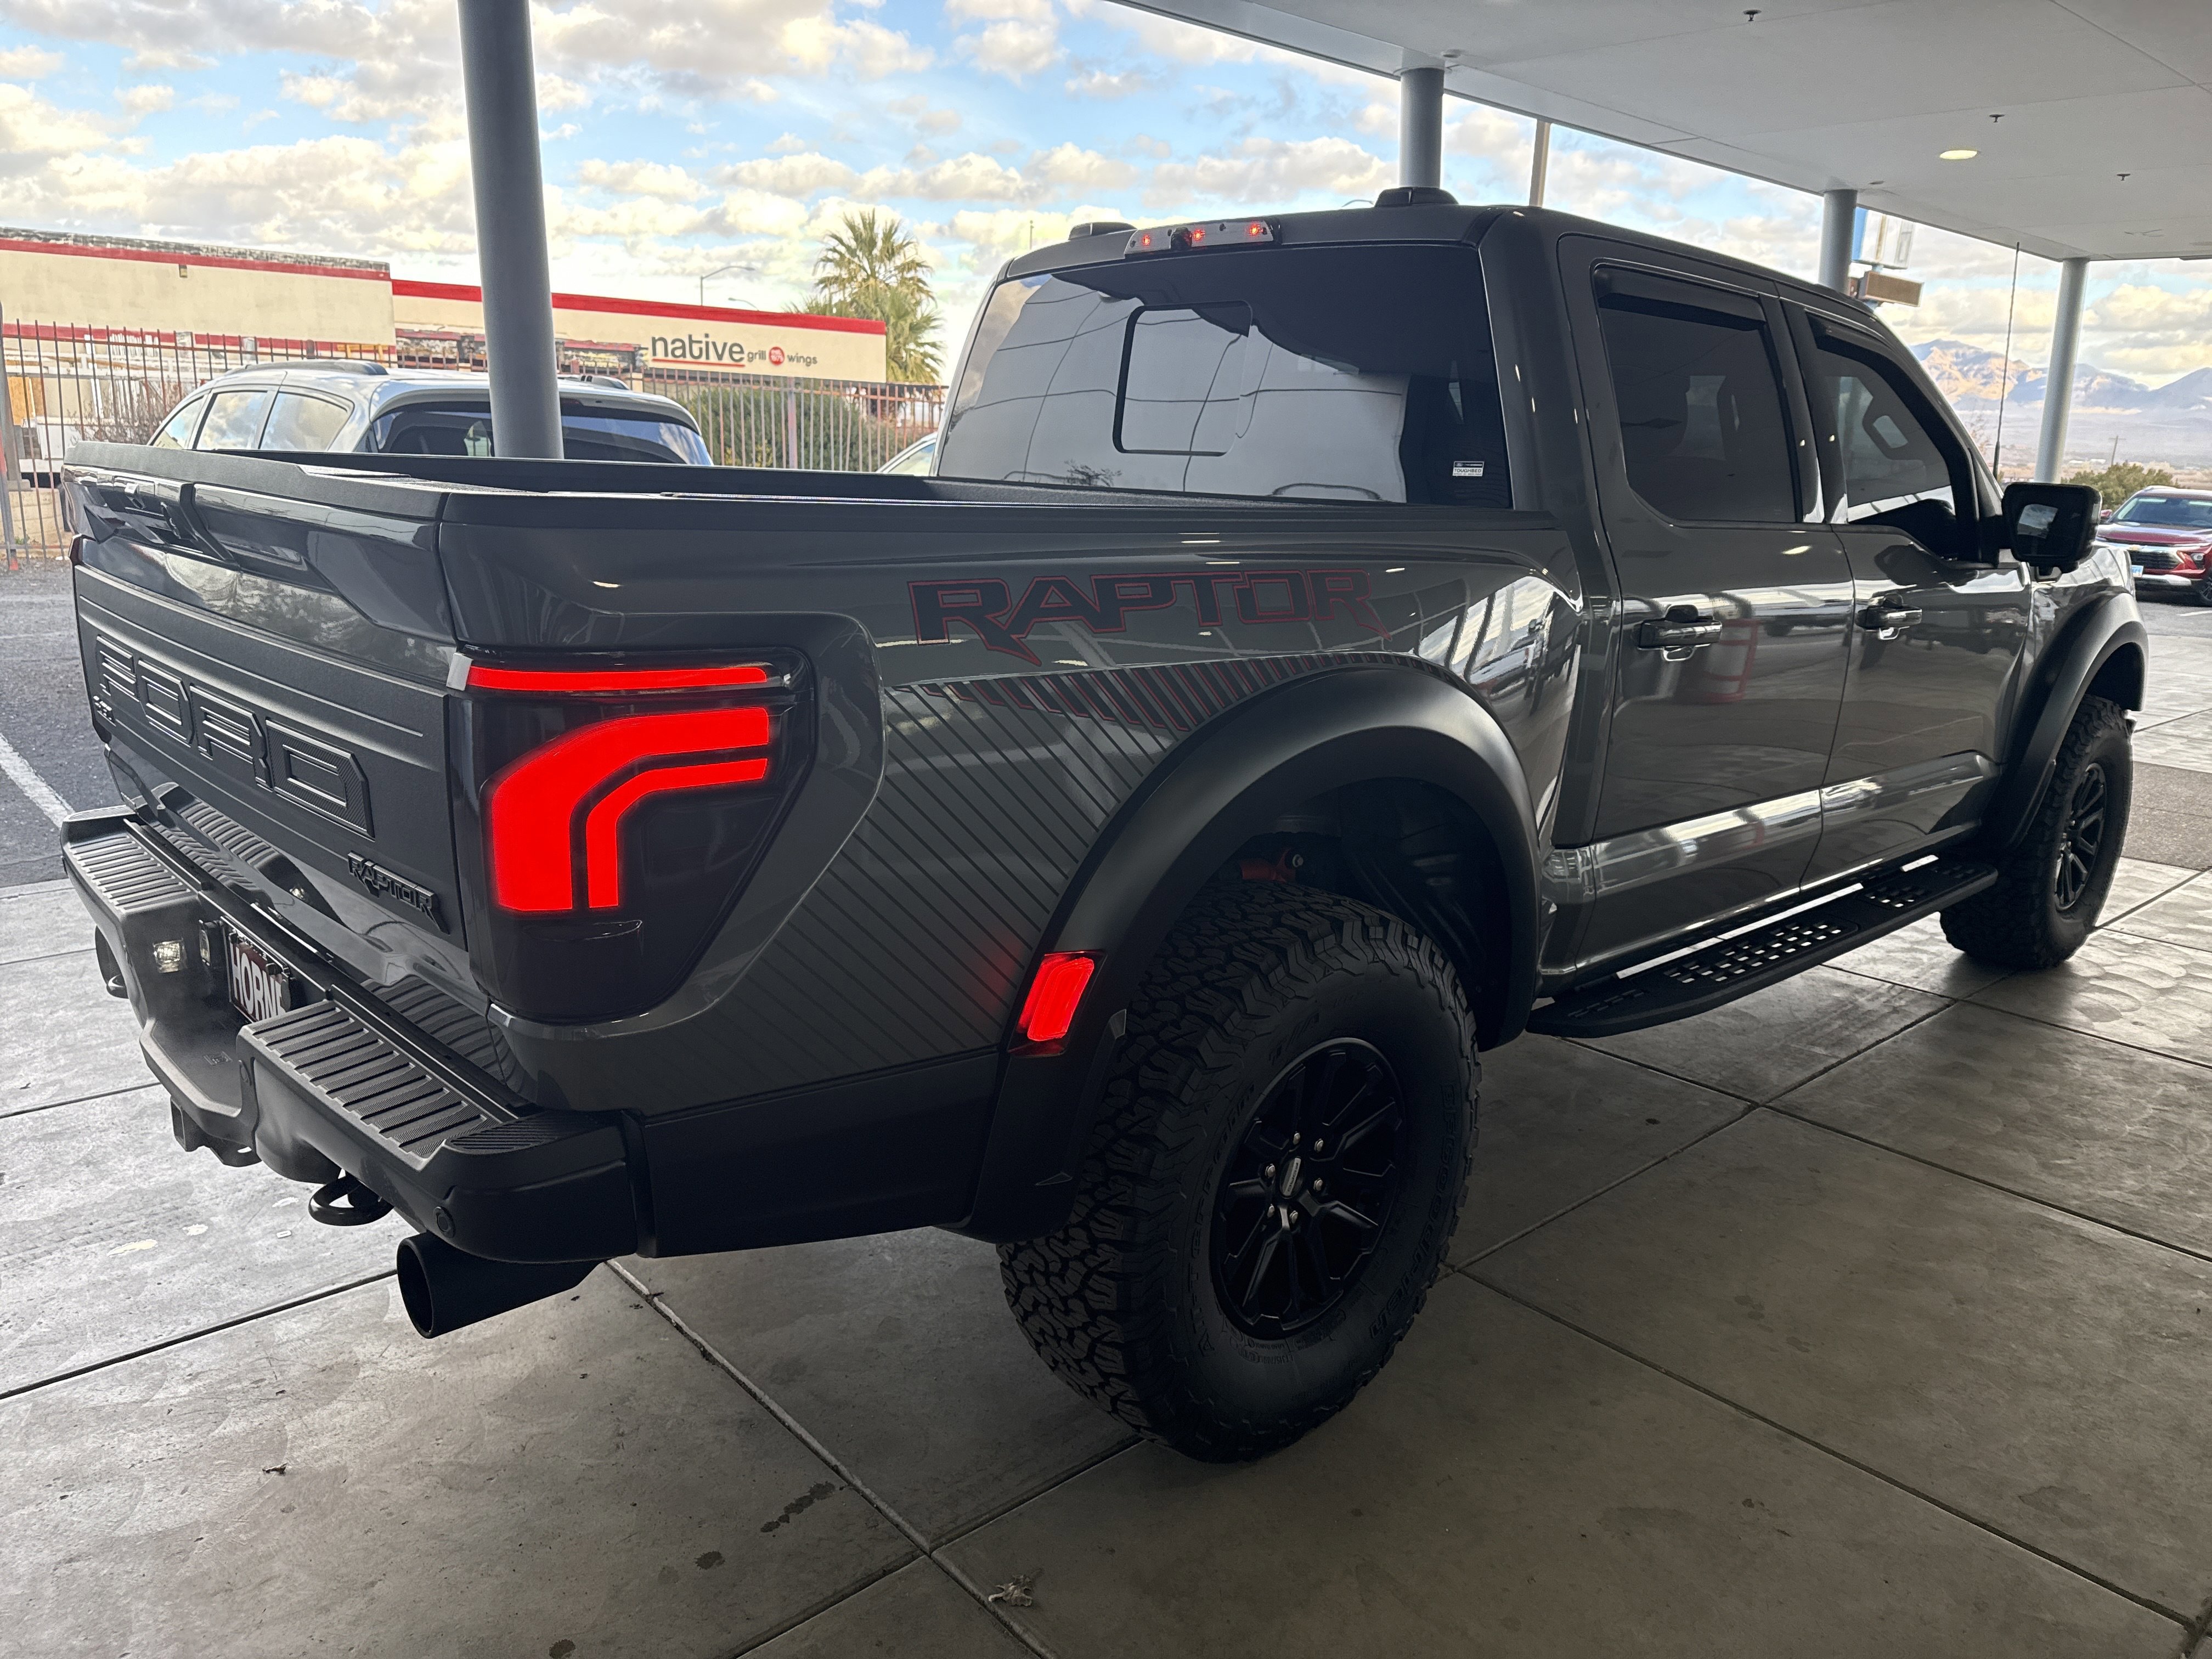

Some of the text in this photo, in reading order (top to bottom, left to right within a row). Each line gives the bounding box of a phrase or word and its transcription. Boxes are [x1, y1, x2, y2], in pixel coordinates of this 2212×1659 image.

[651, 333, 745, 363] native
[747, 350, 766, 363] grill
[787, 353, 818, 367] wings
[907, 568, 1391, 665] RAPTOR
[95, 634, 375, 842] FORD
[347, 850, 451, 936] RAPTOR
